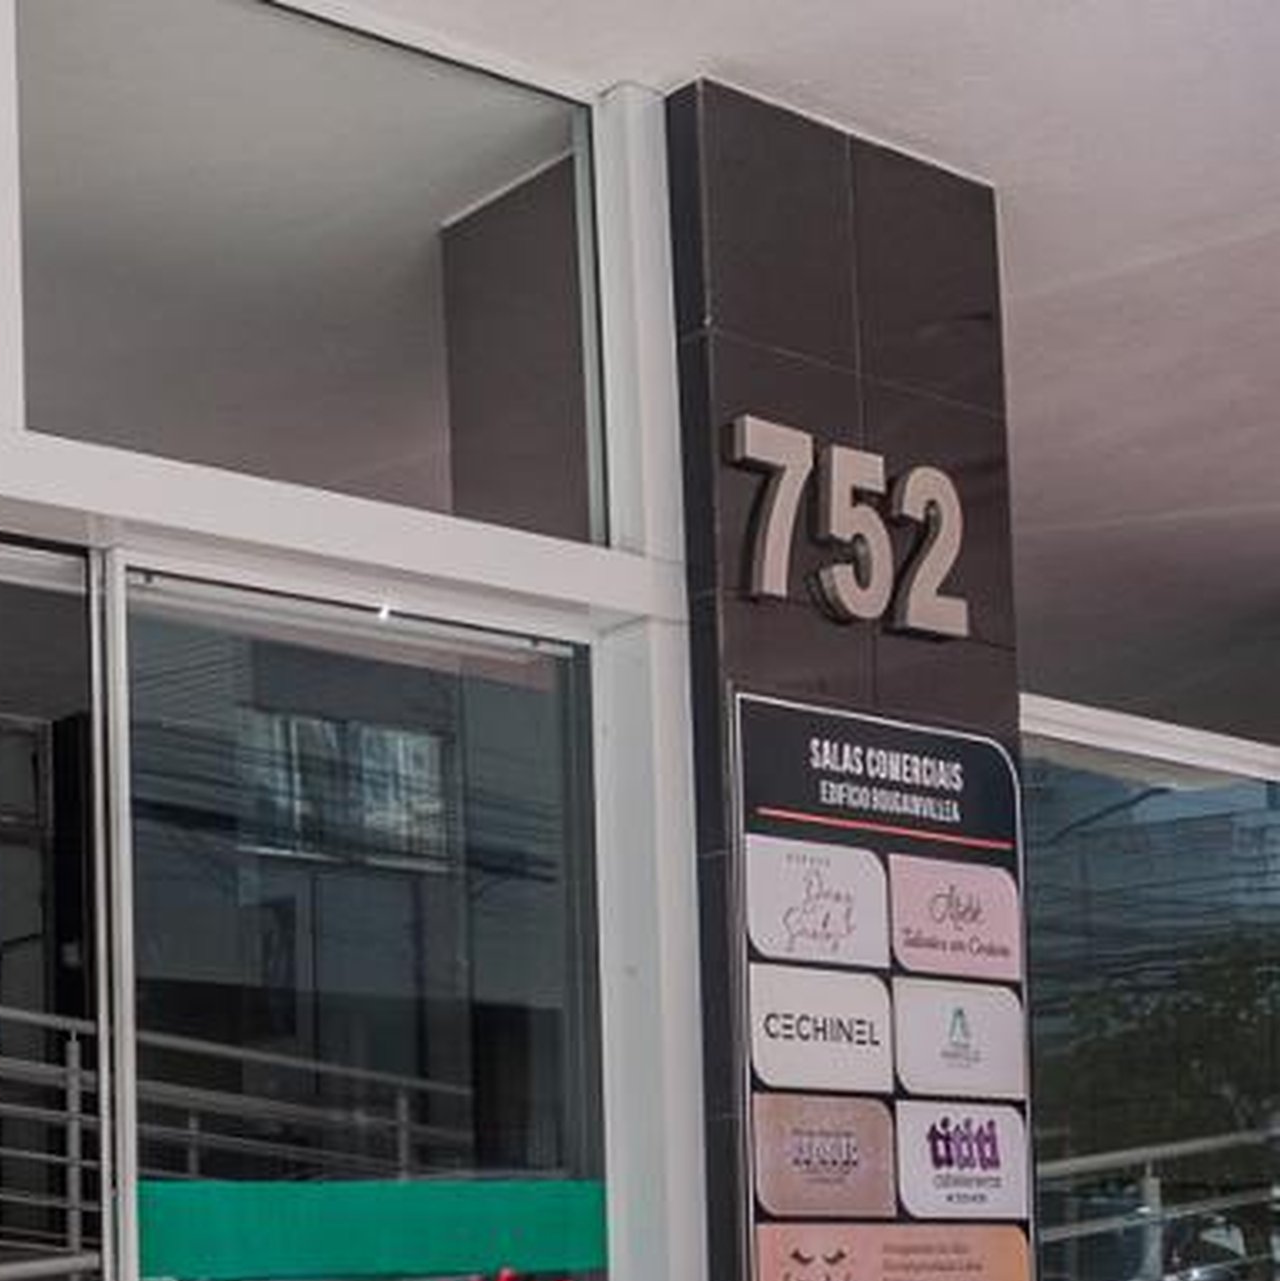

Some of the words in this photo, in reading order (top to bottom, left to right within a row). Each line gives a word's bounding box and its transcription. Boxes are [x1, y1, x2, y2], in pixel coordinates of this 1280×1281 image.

[732, 413, 971, 639] 752
[808, 736, 864, 775] SALAS
[865, 746, 965, 792] COMERCIAIS
[763, 1012, 881, 1047] CECHINEL
